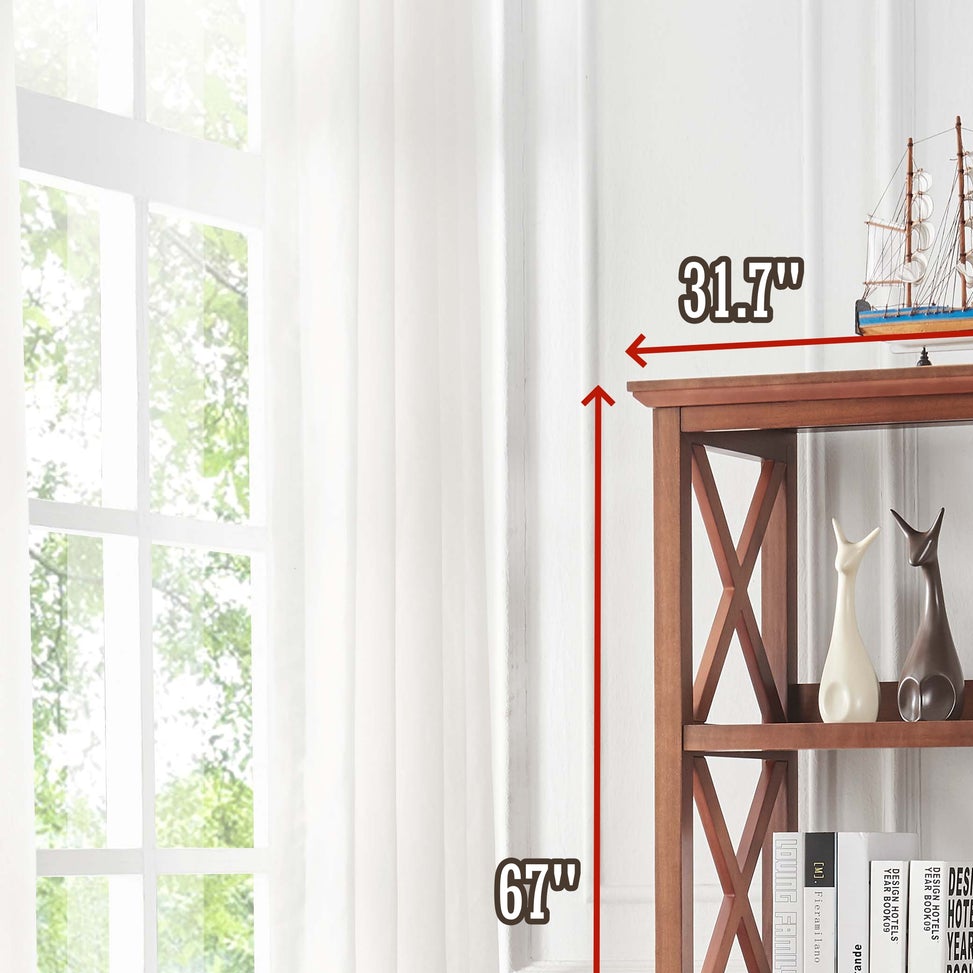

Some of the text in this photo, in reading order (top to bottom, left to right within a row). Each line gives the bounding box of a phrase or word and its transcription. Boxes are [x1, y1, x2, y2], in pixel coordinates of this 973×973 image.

[813, 890, 823, 964] Fieramilano
[882, 868, 892, 933] YEAR BOOK09
[890, 868, 900, 942] DESIGN HOTELS
[923, 866, 932, 932] YEAR BOOK09
[931, 866, 941, 941] DESIGN HOTELS
